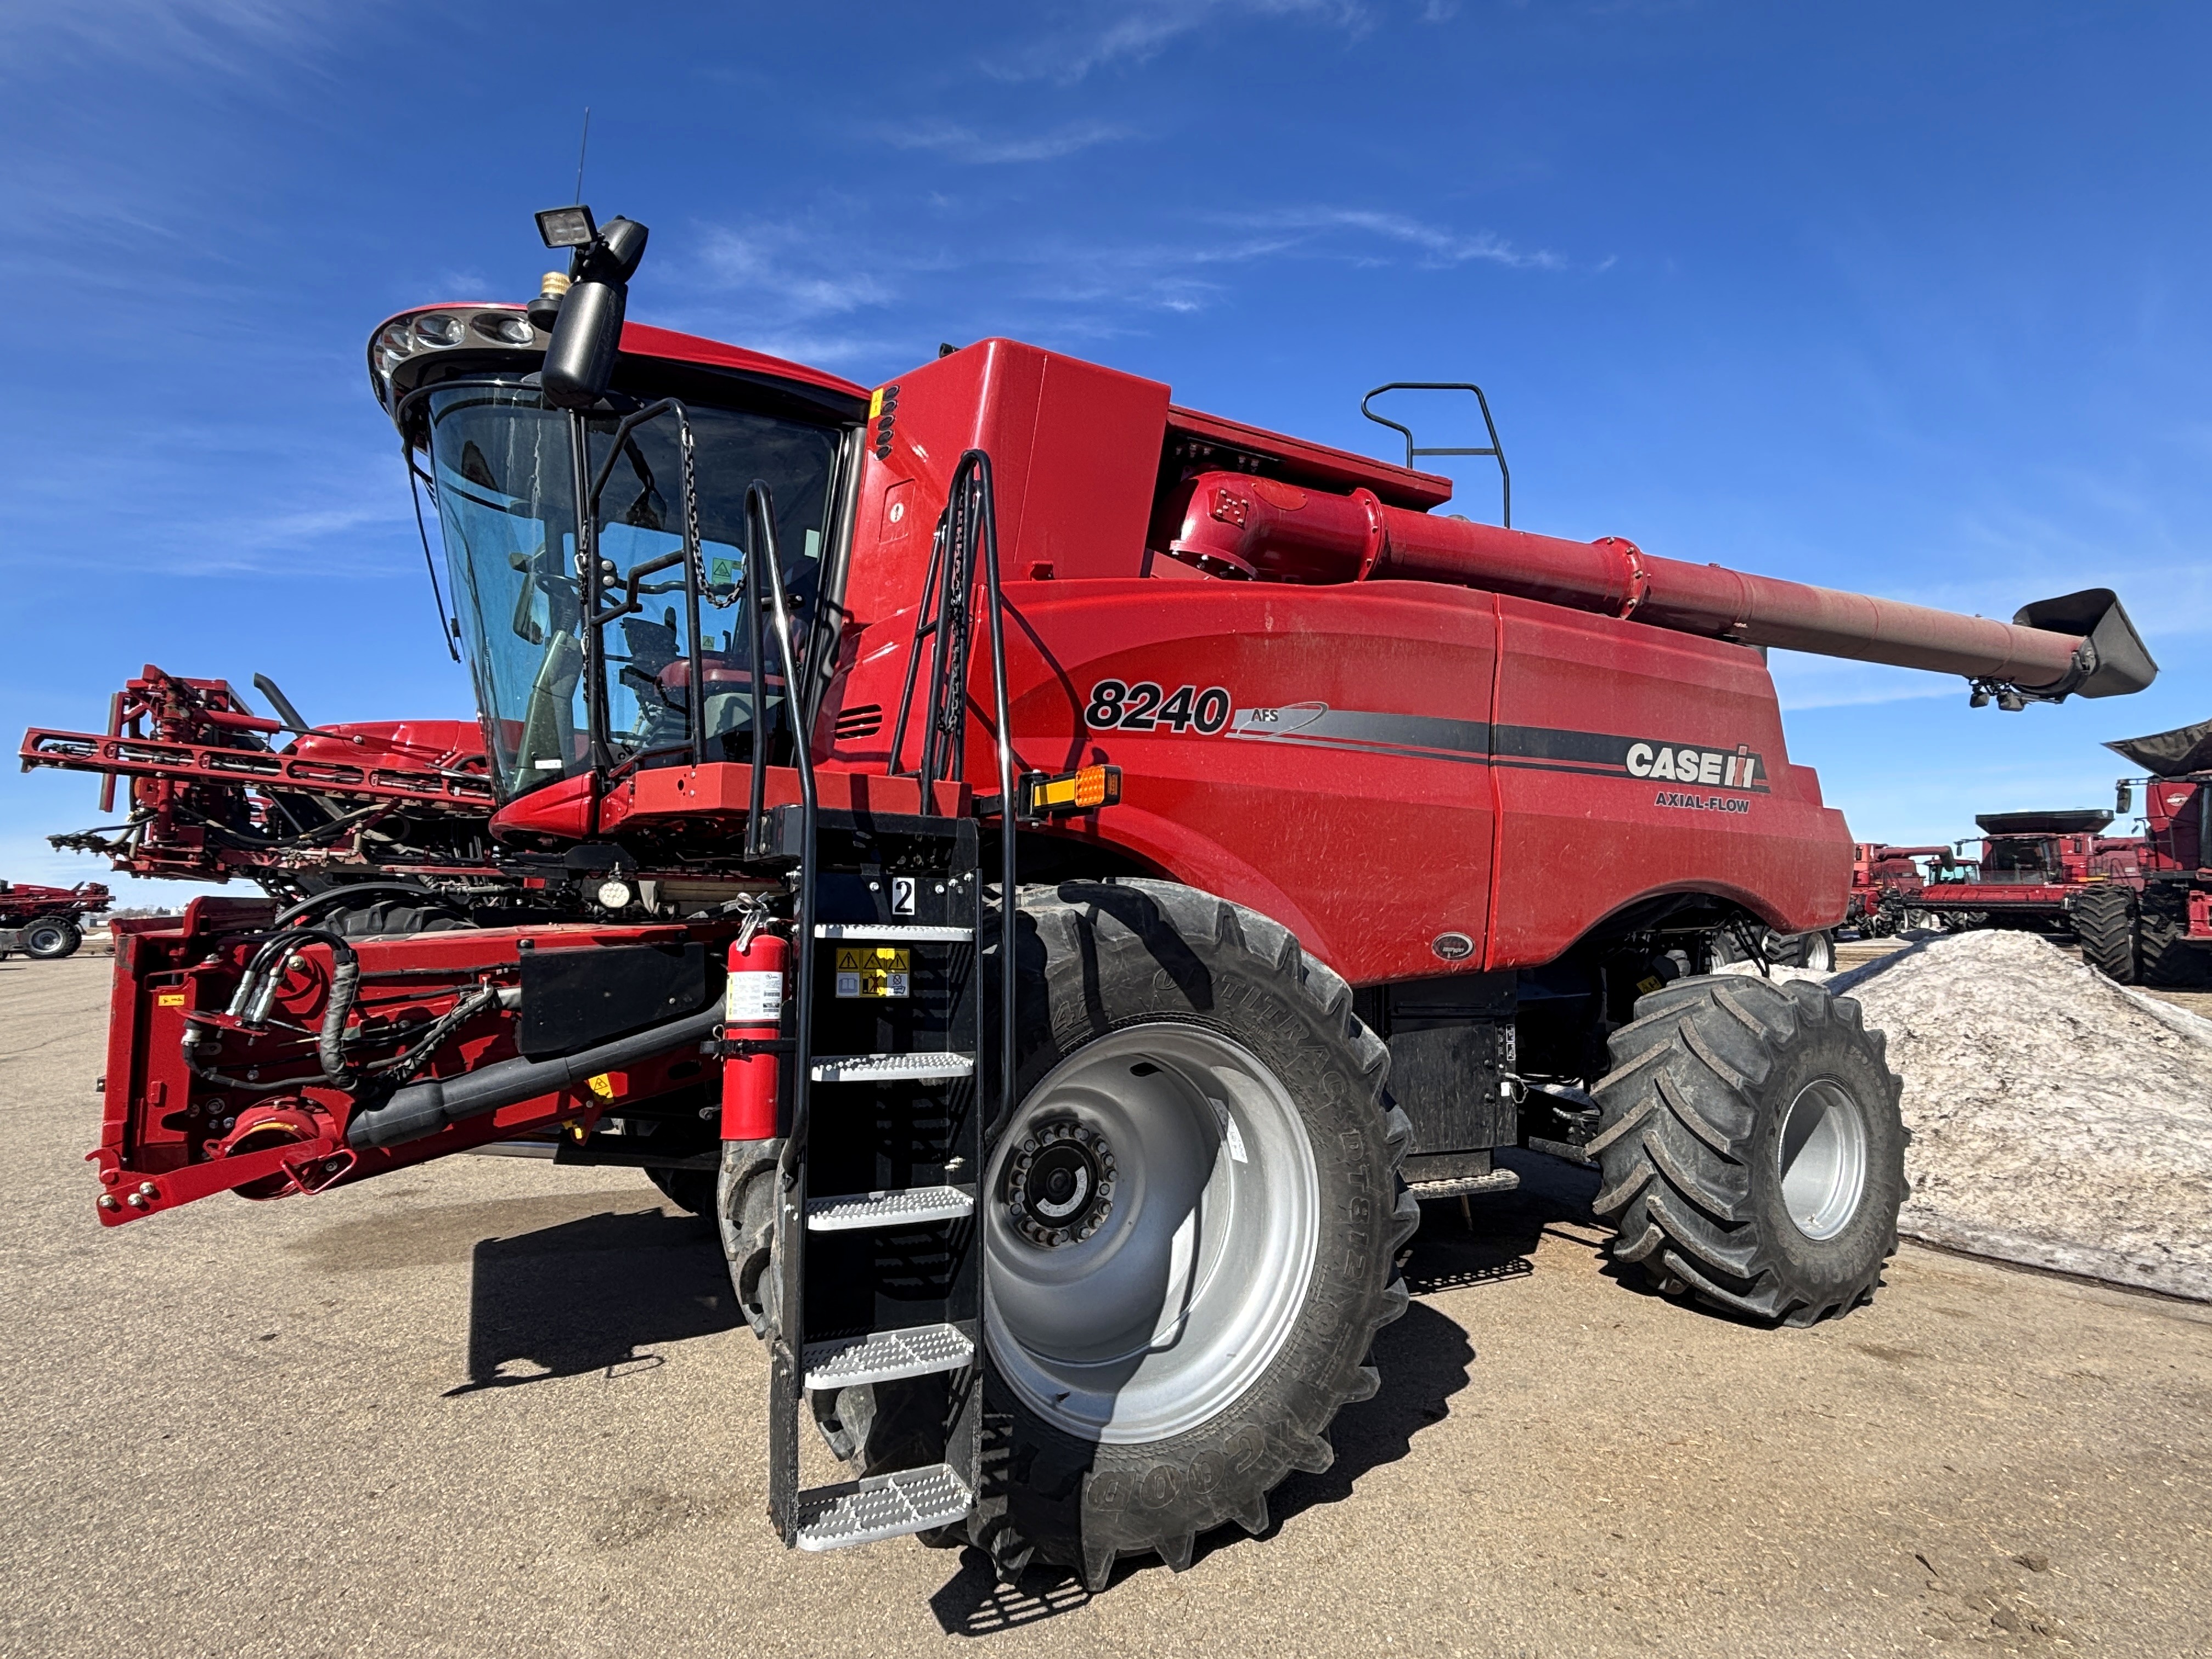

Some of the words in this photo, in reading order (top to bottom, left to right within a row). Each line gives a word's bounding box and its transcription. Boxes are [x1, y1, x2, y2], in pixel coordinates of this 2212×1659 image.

[1085, 679, 1231, 735] 8240
[1251, 709, 1279, 722] AFS
[1627, 743, 1723, 785] CASE
[1655, 792, 1749, 813] AXIAL-FLOW
[895, 881, 912, 912] 2
